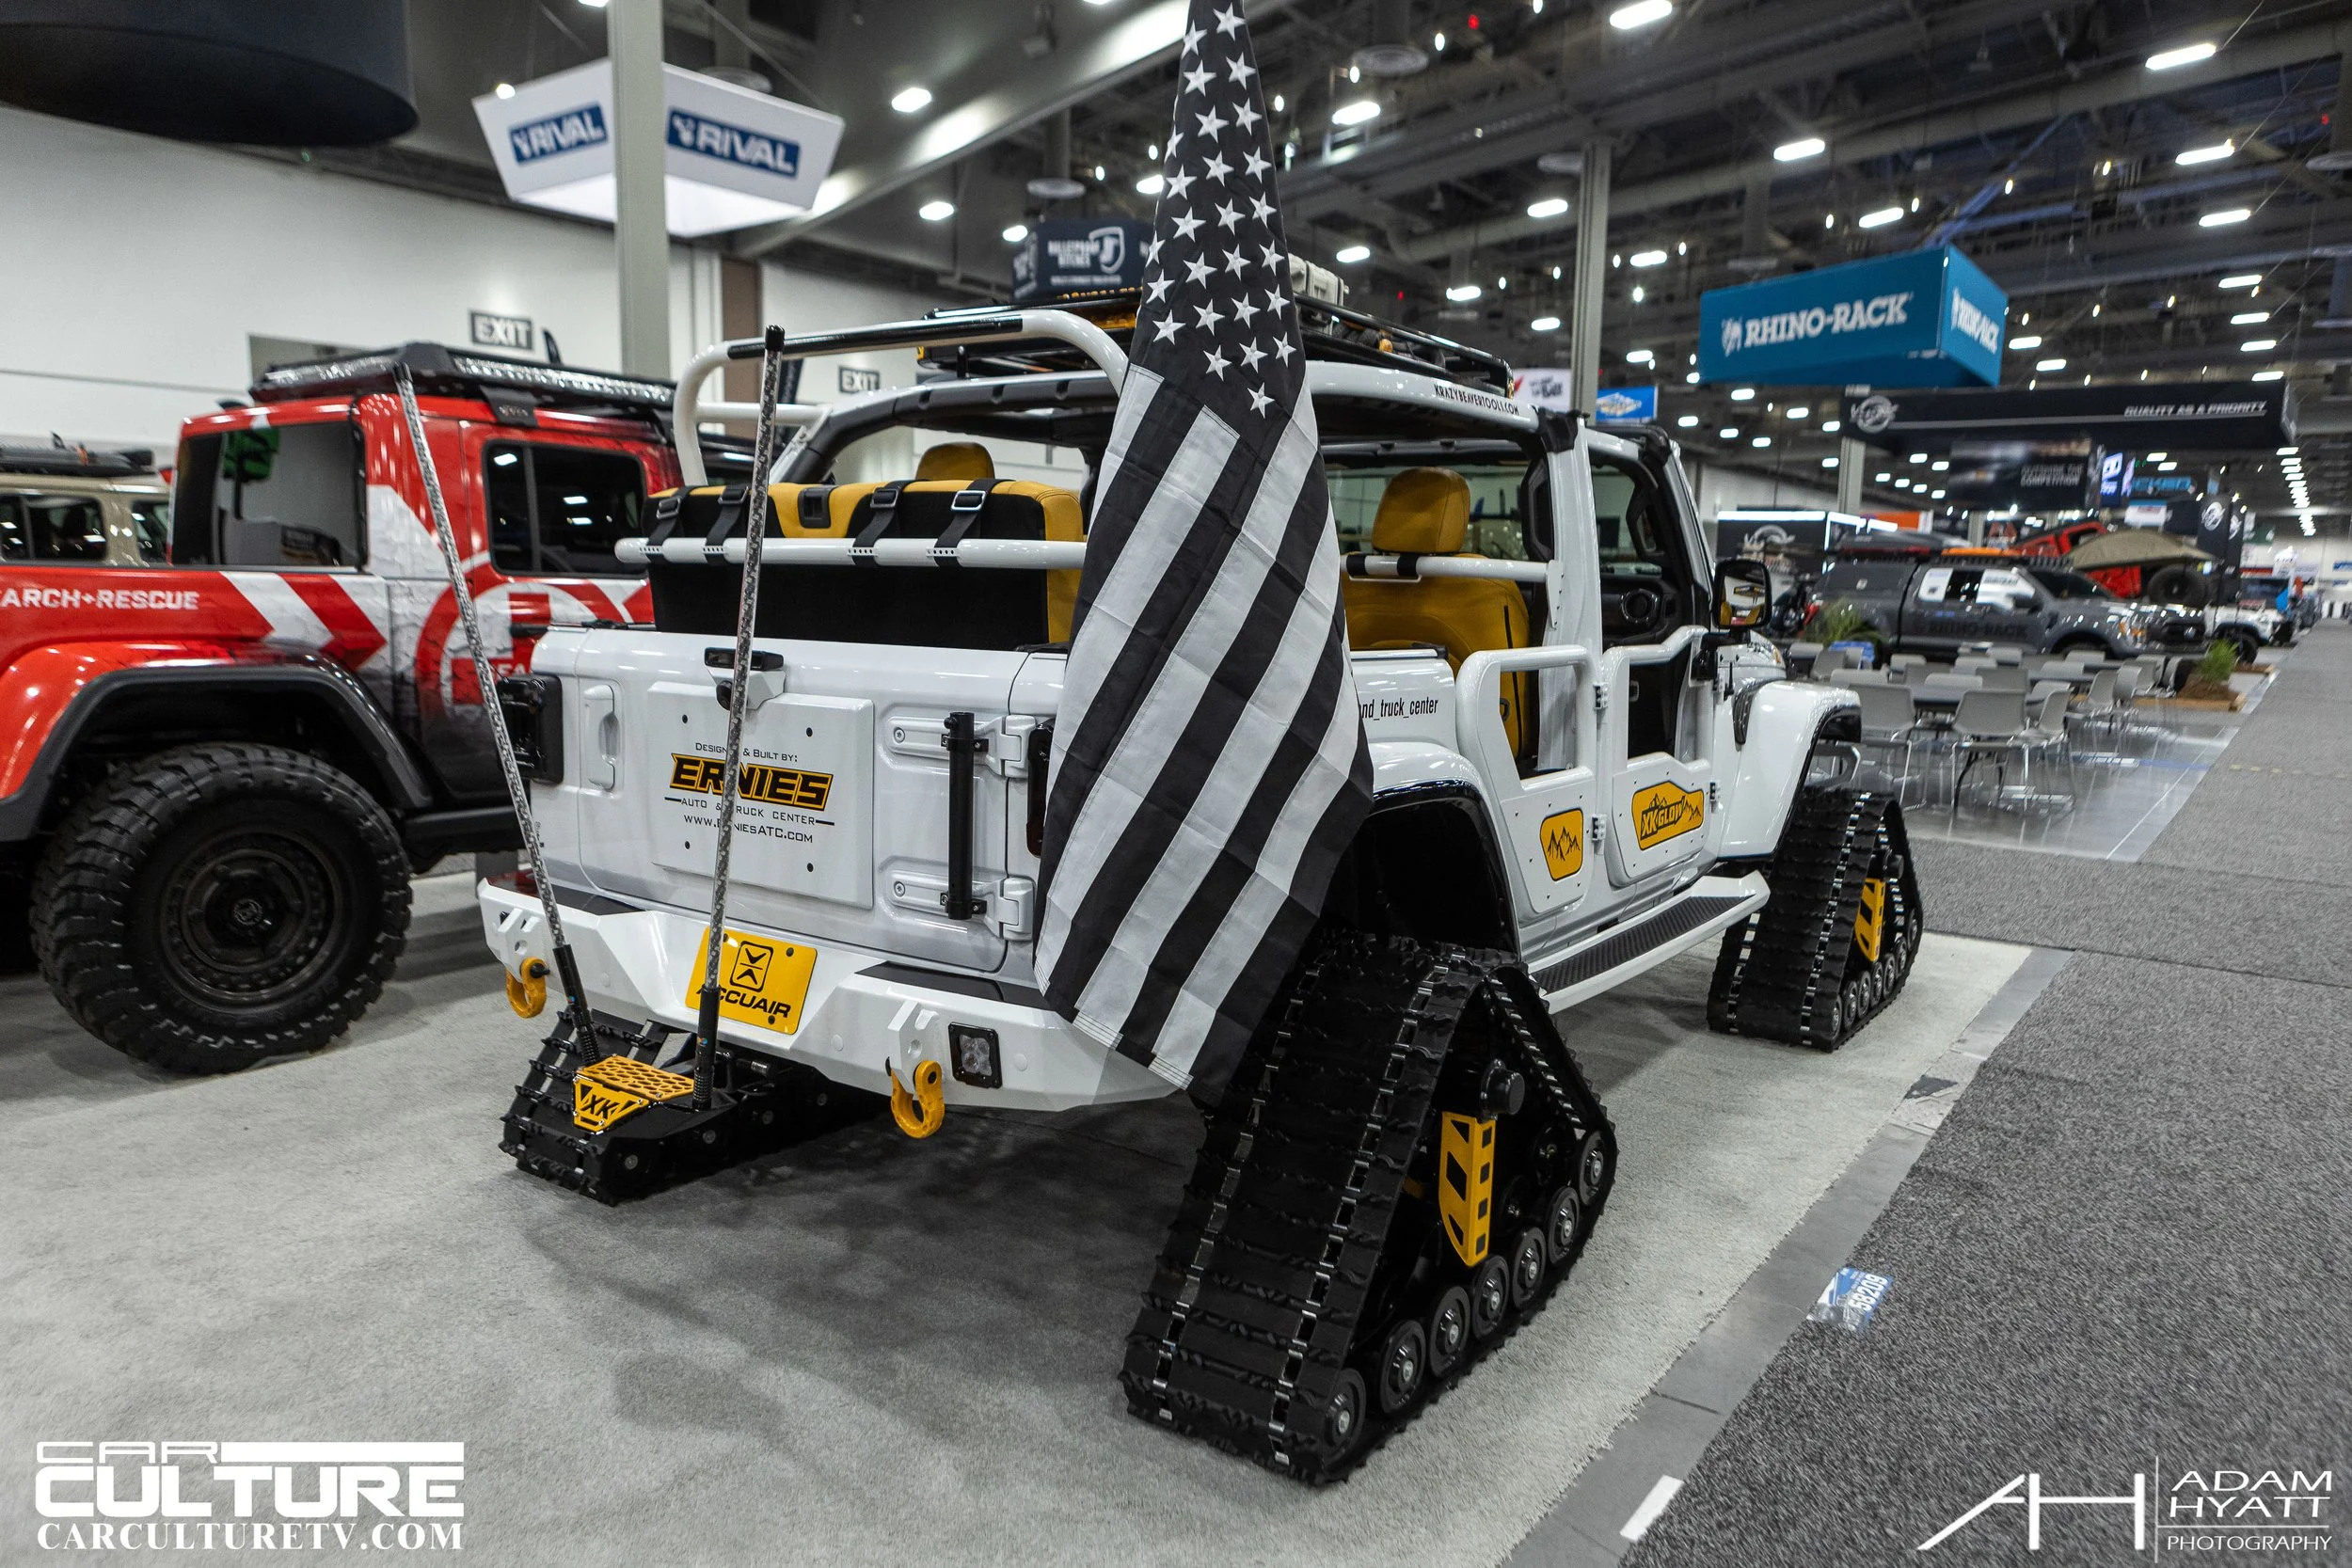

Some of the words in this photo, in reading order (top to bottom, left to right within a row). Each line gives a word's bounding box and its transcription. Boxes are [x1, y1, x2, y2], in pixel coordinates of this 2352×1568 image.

[531, 114, 604, 157] RIVAL
[696, 123, 795, 175] RIVAL
[475, 316, 531, 346] EXIT
[1744, 292, 1909, 348] RHINO-RACK
[841, 370, 878, 391] EXIT
[0, 588, 199, 610] ARCH+RESCUE
[1361, 696, 1438, 721] nd_truck_center
[743, 748, 751, 757] &
[670, 753, 834, 811] ERNIES
[681, 798, 707, 809] AUTO
[736, 806, 764, 817] RUCK
[772, 811, 816, 825] CENTER
[696, 984, 791, 1018] CCUAIR
[580, 1095, 620, 1119] XK
[1848, 1273, 1888, 1311] 58209
